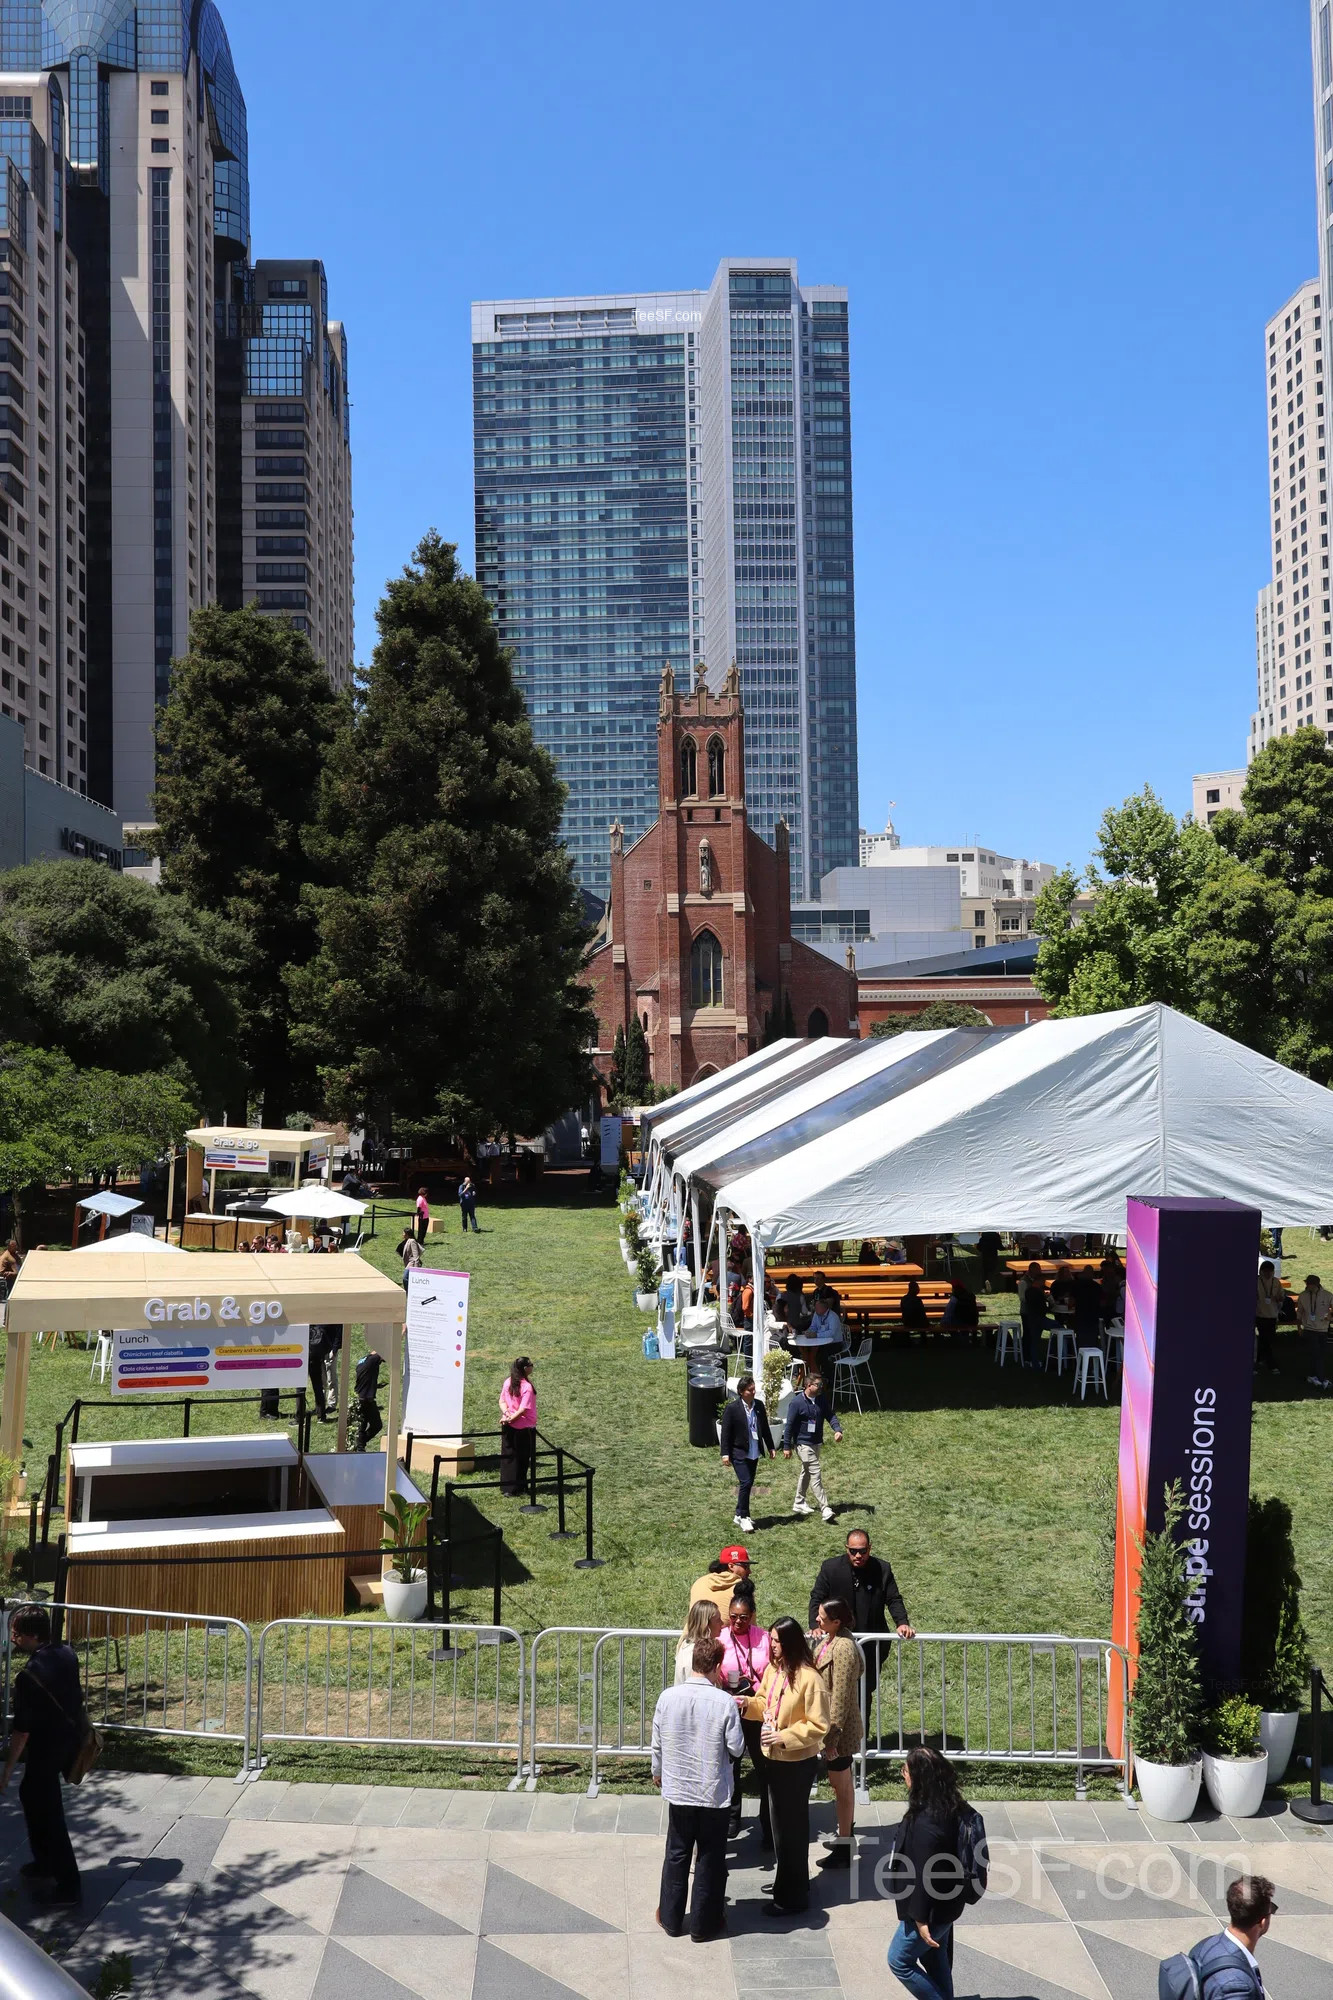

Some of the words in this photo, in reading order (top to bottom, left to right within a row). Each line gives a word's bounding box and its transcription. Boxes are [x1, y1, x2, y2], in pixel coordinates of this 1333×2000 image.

[213, 1136, 235, 1148] Grab
[237, 1137, 246, 1149] &
[246, 1140, 259, 1152] go
[132, 1216, 146, 1225] Exit
[411, 1276, 430, 1286] Lunch
[144, 1297, 212, 1322] Grab
[218, 1296, 242, 1321] &
[248, 1300, 284, 1325] go
[119, 1334, 149, 1345] Lunch
[1184, 1387, 1217, 1531] sessions
